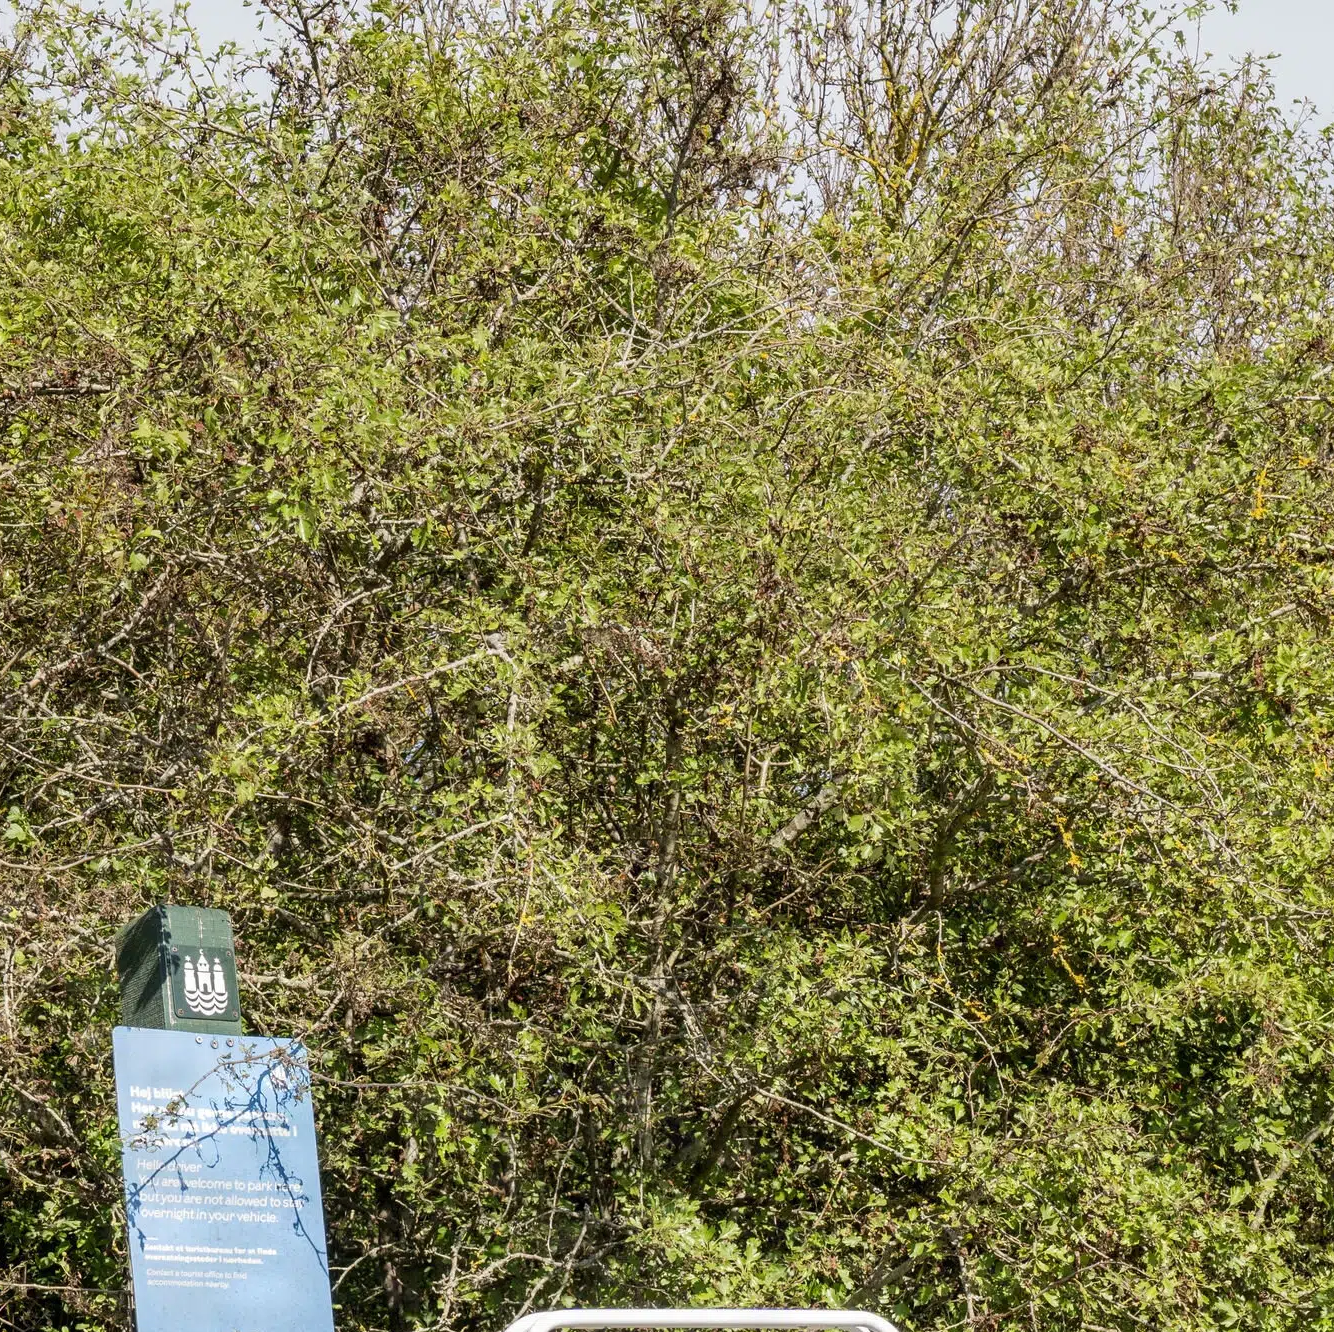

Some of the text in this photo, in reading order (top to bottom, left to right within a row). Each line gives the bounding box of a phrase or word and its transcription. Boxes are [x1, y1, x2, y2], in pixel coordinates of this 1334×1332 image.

[166, 1161, 202, 1173] driver
[234, 1180, 246, 1190] to
[248, 1181, 272, 1194] park
[160, 1193, 182, 1205] you
[183, 1195, 204, 1205] are
[204, 1195, 224, 1205] not
[225, 1194, 267, 1207] allowed
[270, 1197, 281, 1208] to
[141, 1205, 279, 1224] overnight in your vehicle.
